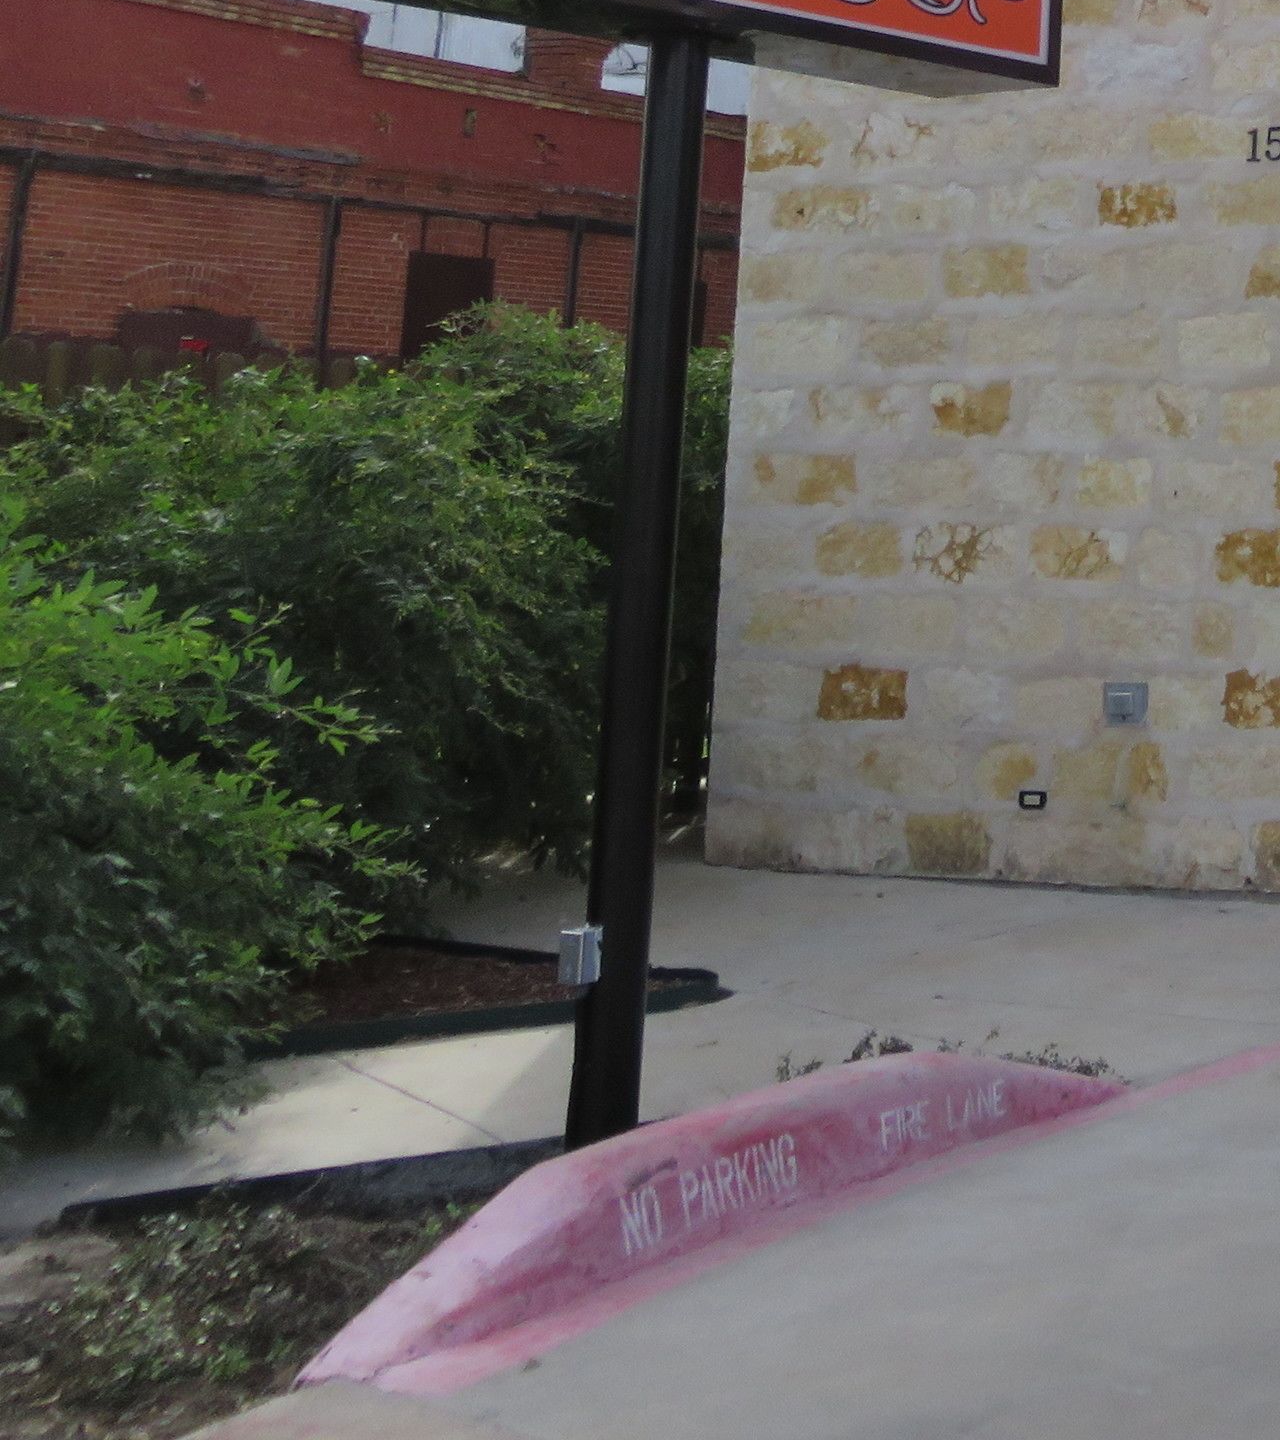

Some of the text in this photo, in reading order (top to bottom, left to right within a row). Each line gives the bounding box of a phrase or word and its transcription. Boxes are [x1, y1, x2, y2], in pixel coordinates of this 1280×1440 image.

[619, 1079, 1007, 1255] NO PARKING FIRE LANE
